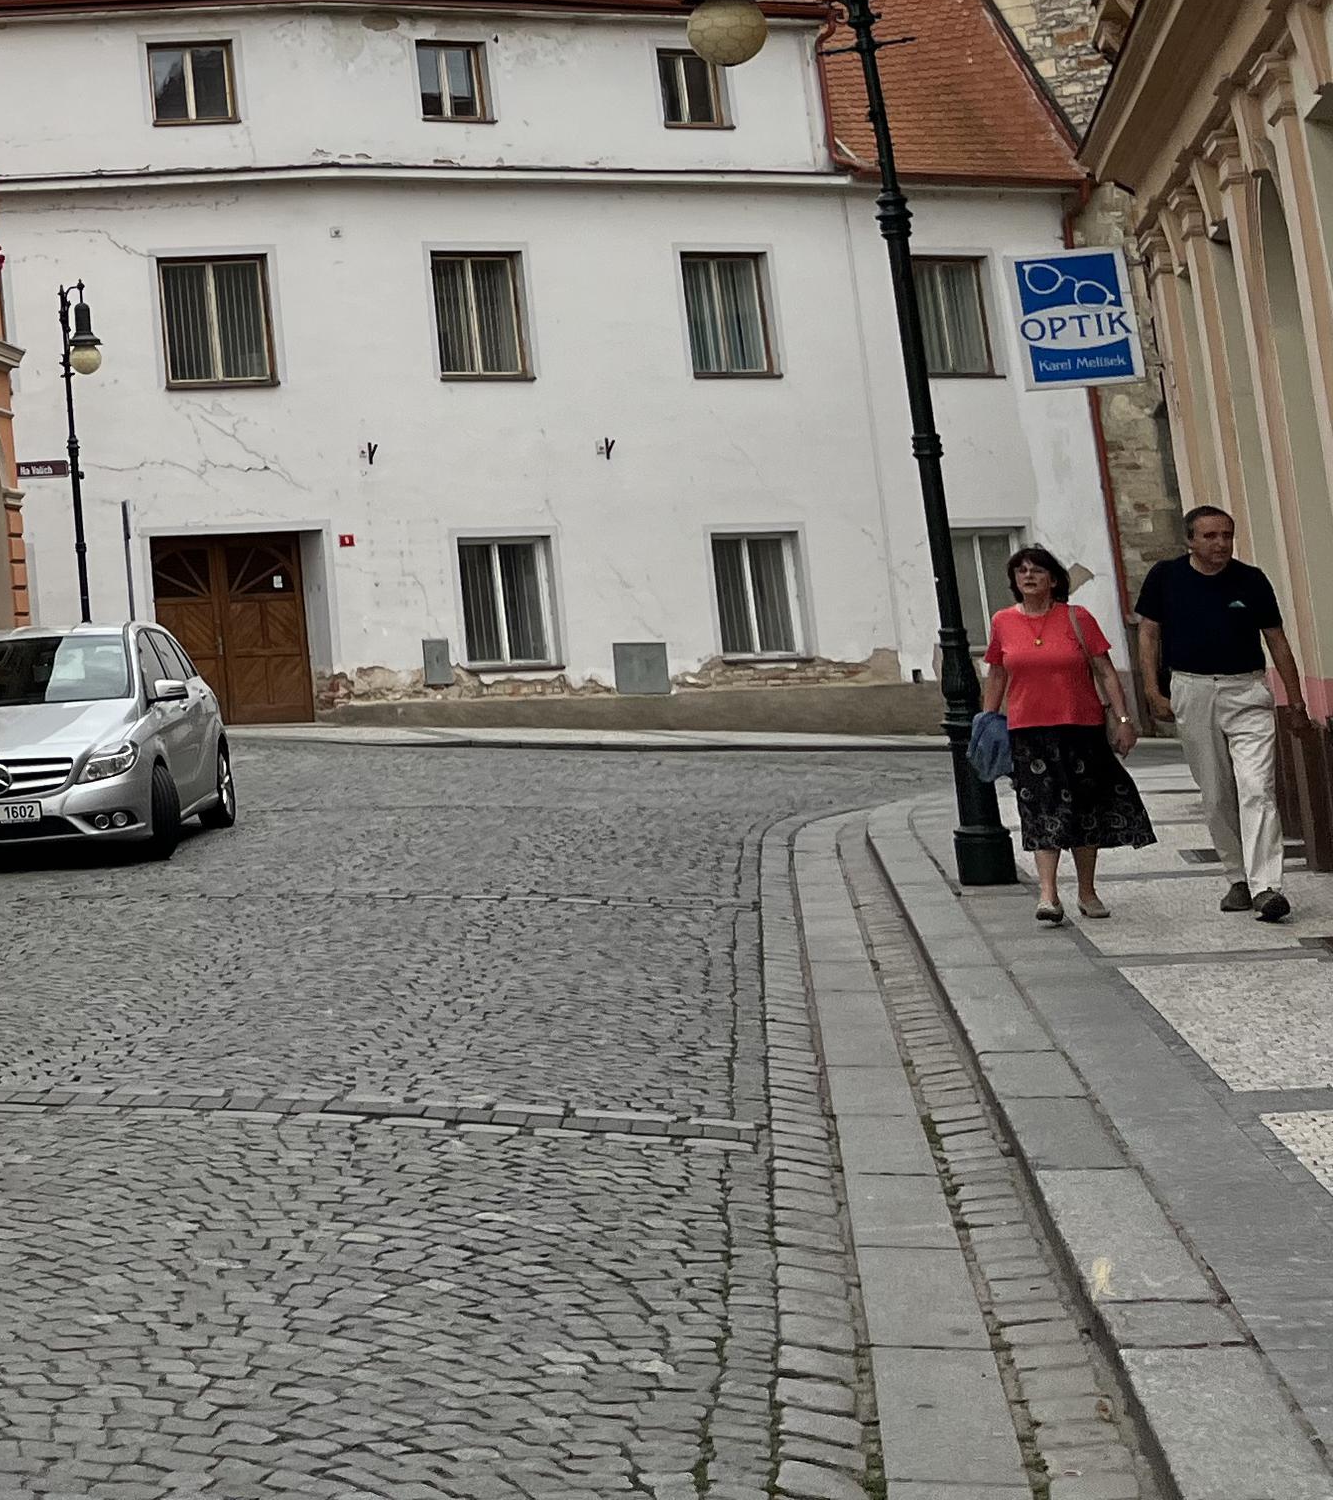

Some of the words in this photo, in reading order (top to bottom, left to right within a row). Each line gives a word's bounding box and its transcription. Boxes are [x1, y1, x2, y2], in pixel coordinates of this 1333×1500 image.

[1021, 311, 1132, 341] OPTIK
[1039, 359, 1072, 372] Karel
[20, 466, 31, 476] Na
[4, 805, 35, 819] 1602
